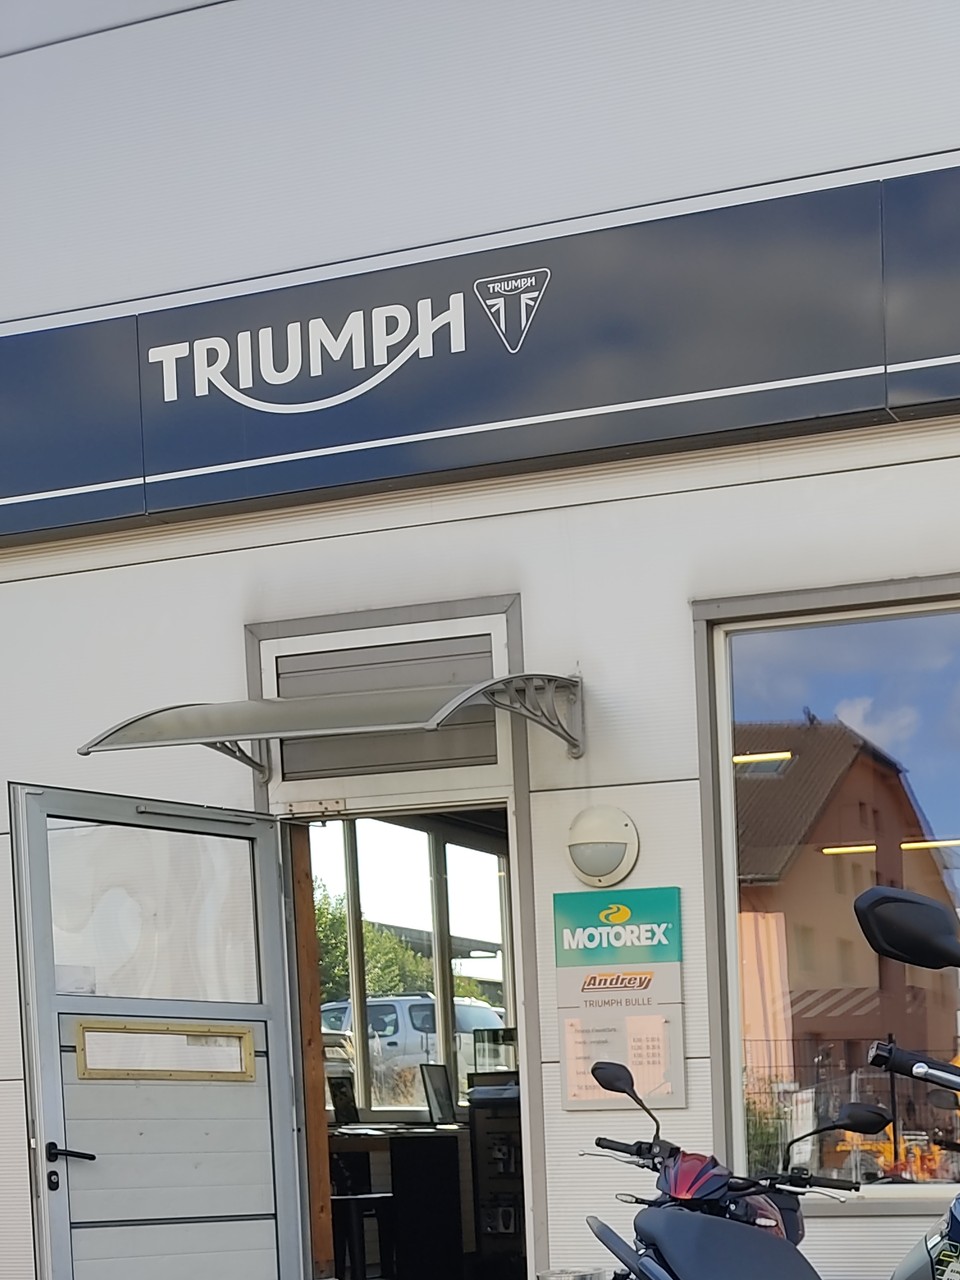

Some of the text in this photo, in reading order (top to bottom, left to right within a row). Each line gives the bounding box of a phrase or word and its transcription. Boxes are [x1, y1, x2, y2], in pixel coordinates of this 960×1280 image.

[487, 275, 536, 295] TRIUMPH
[147, 291, 467, 414] TRIUMPH
[584, 973, 651, 991] Andrey
[583, 997, 653, 1009] TRIUMPH BULLE
